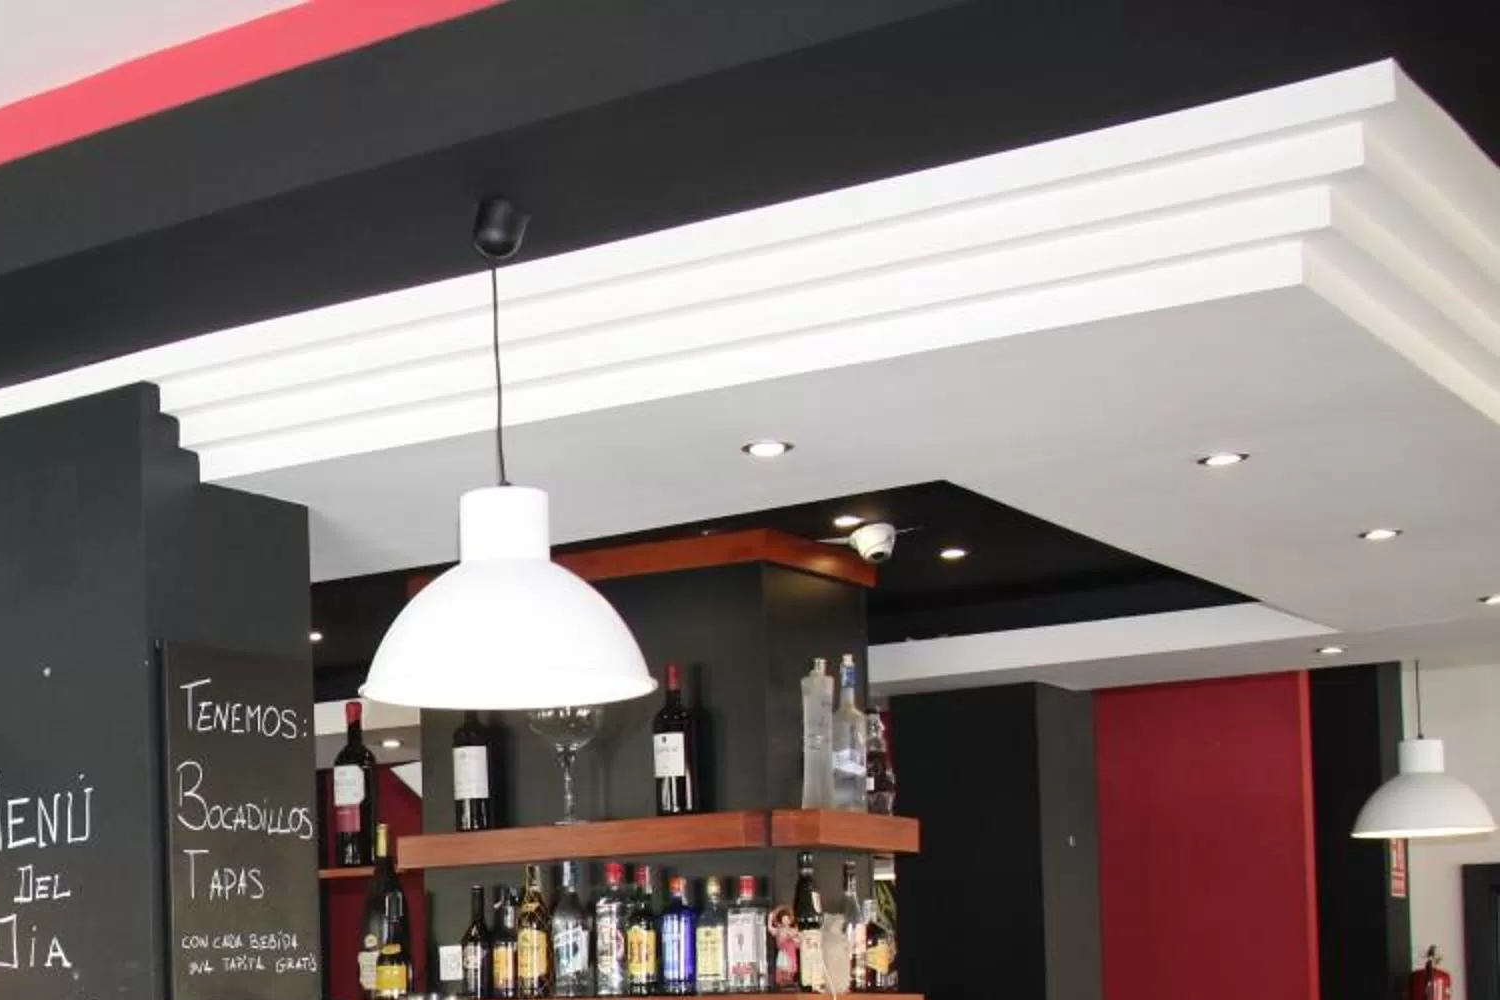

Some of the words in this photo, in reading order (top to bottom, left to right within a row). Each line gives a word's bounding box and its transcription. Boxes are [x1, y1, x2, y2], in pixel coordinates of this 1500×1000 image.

[179, 677, 308, 739] TENEMOS:
[176, 759, 314, 840] BOCADILLOS
[13, 863, 72, 904] DEL
[182, 849, 265, 902] TAPAS
[181, 934, 209, 950] CON
